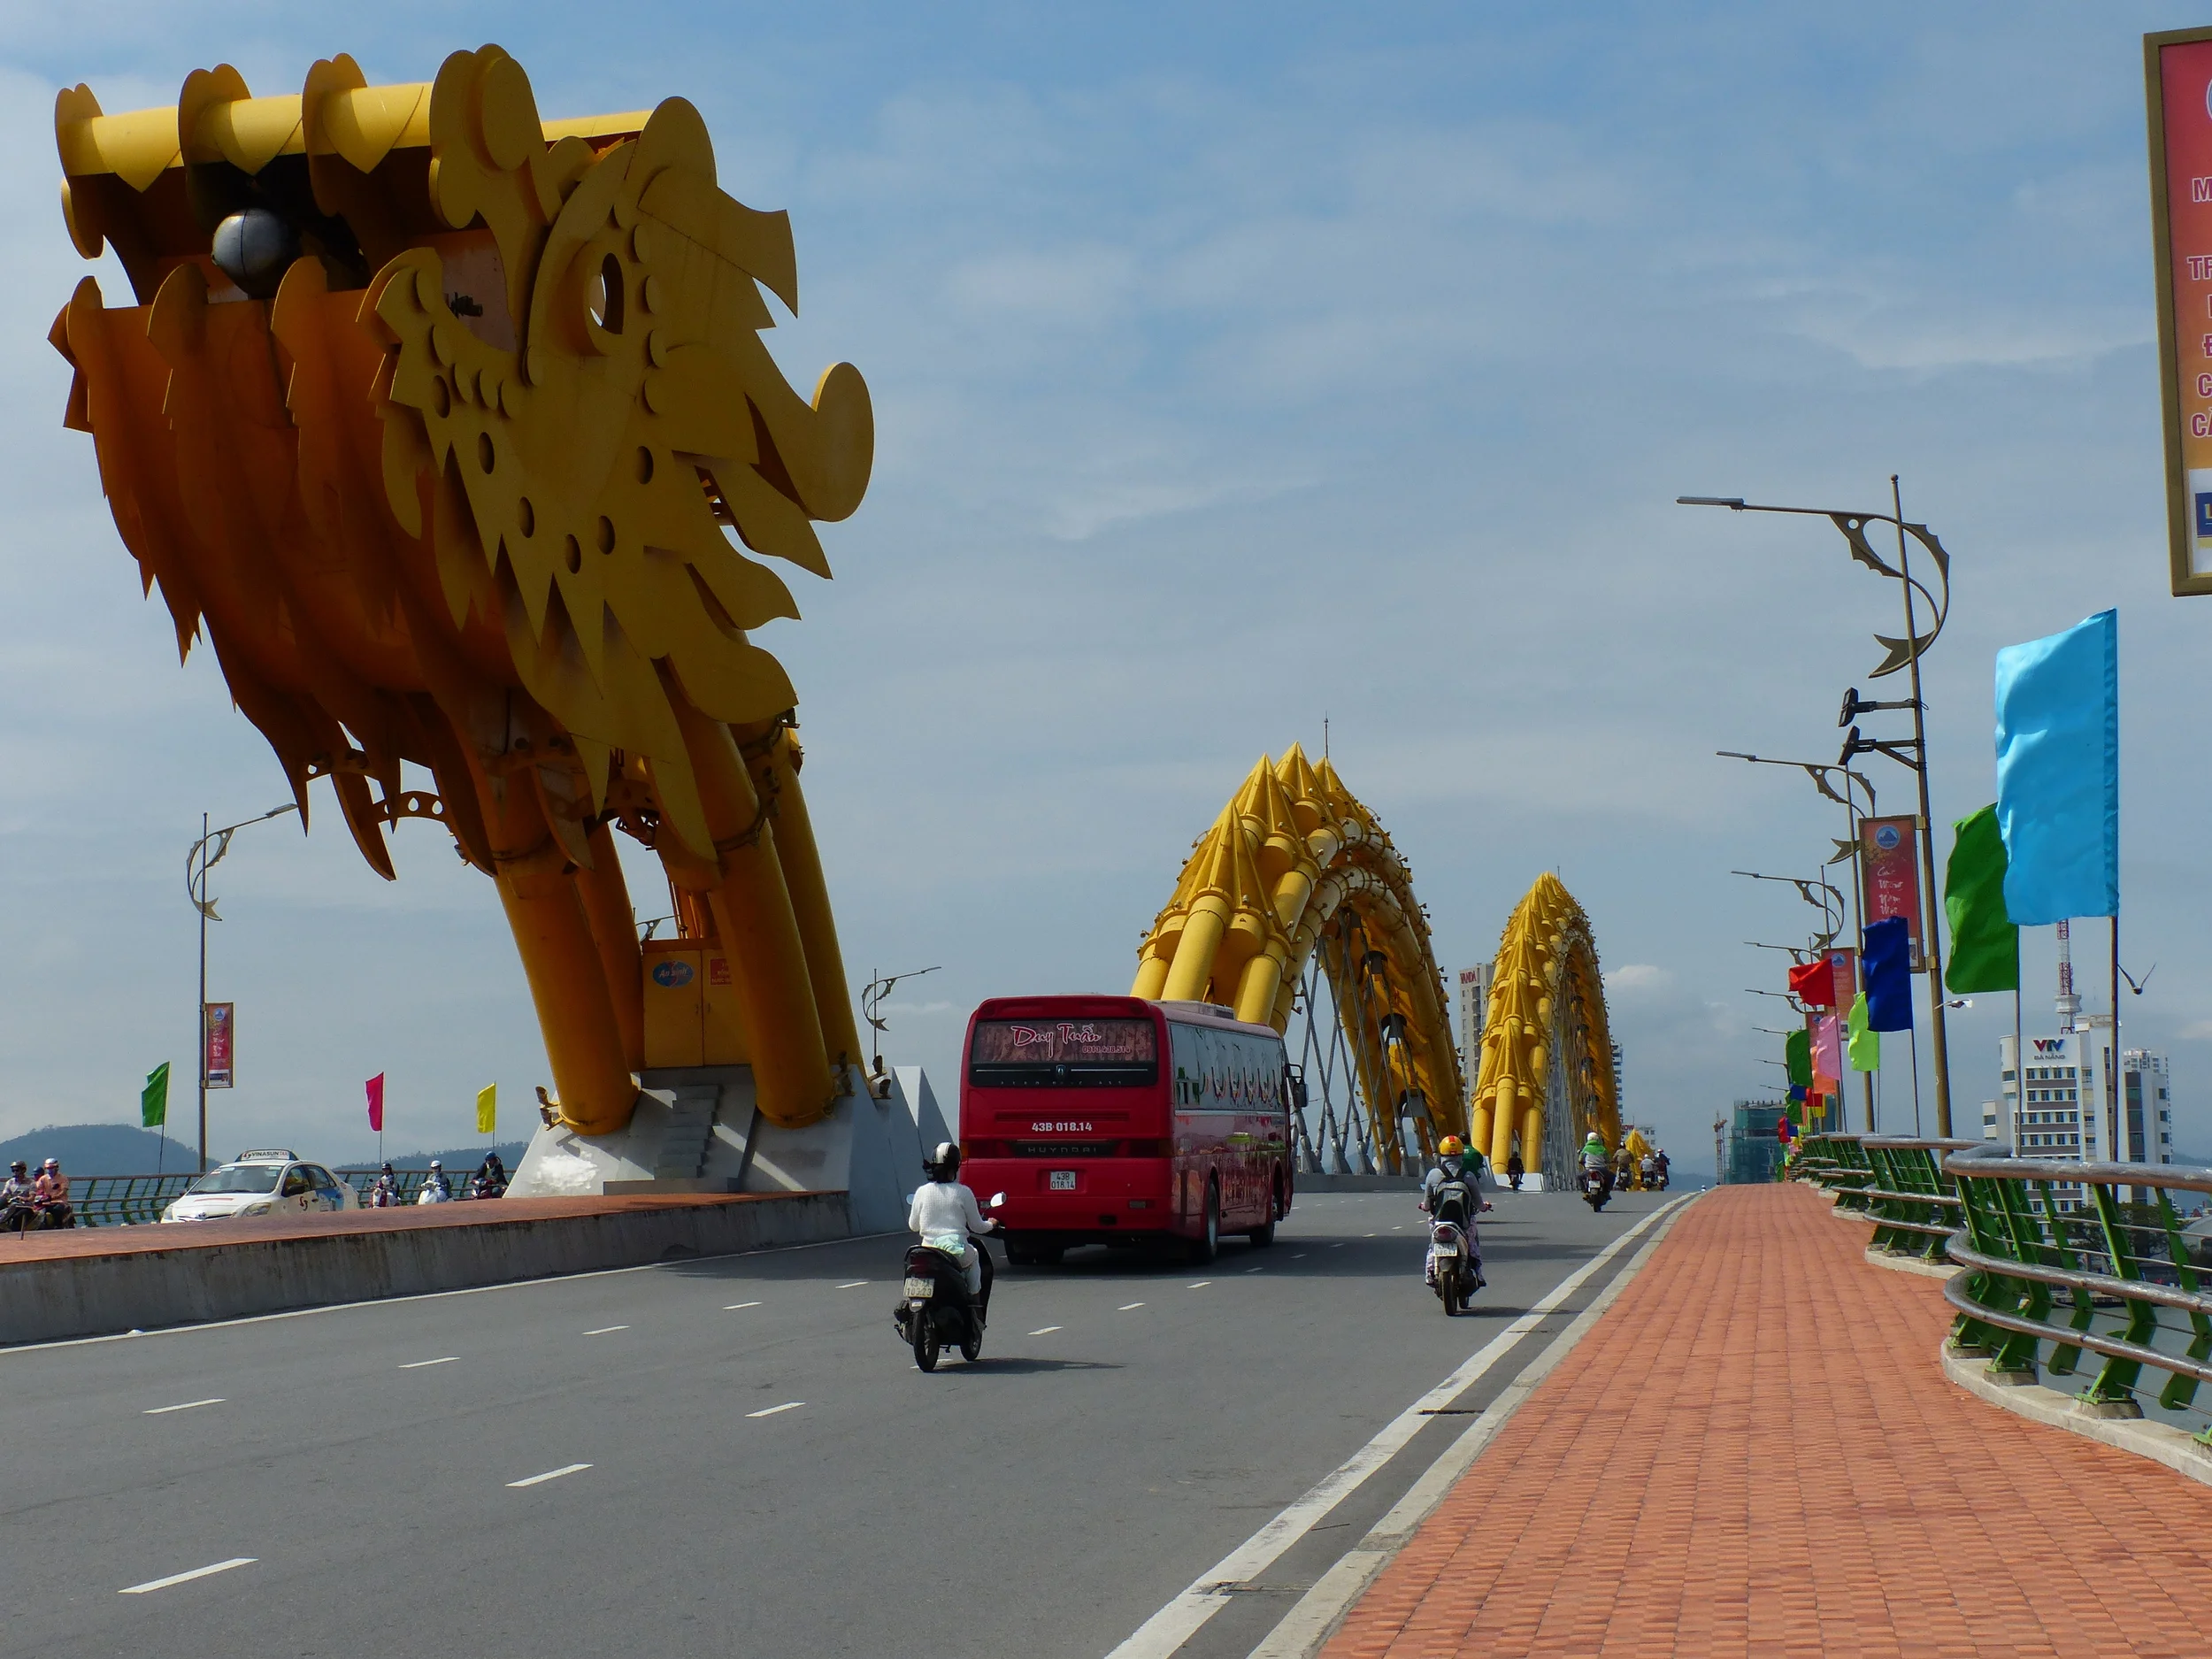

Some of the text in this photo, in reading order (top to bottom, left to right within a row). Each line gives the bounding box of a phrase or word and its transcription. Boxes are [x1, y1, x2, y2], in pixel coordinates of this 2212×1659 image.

[1011, 1023, 1102, 1057] Duy Tuấn
[2032, 1039, 2064, 1052] VTV
[1056, 1122, 1093, 1132] 018.14
[1051, 1180, 1075, 1189] 018.14
